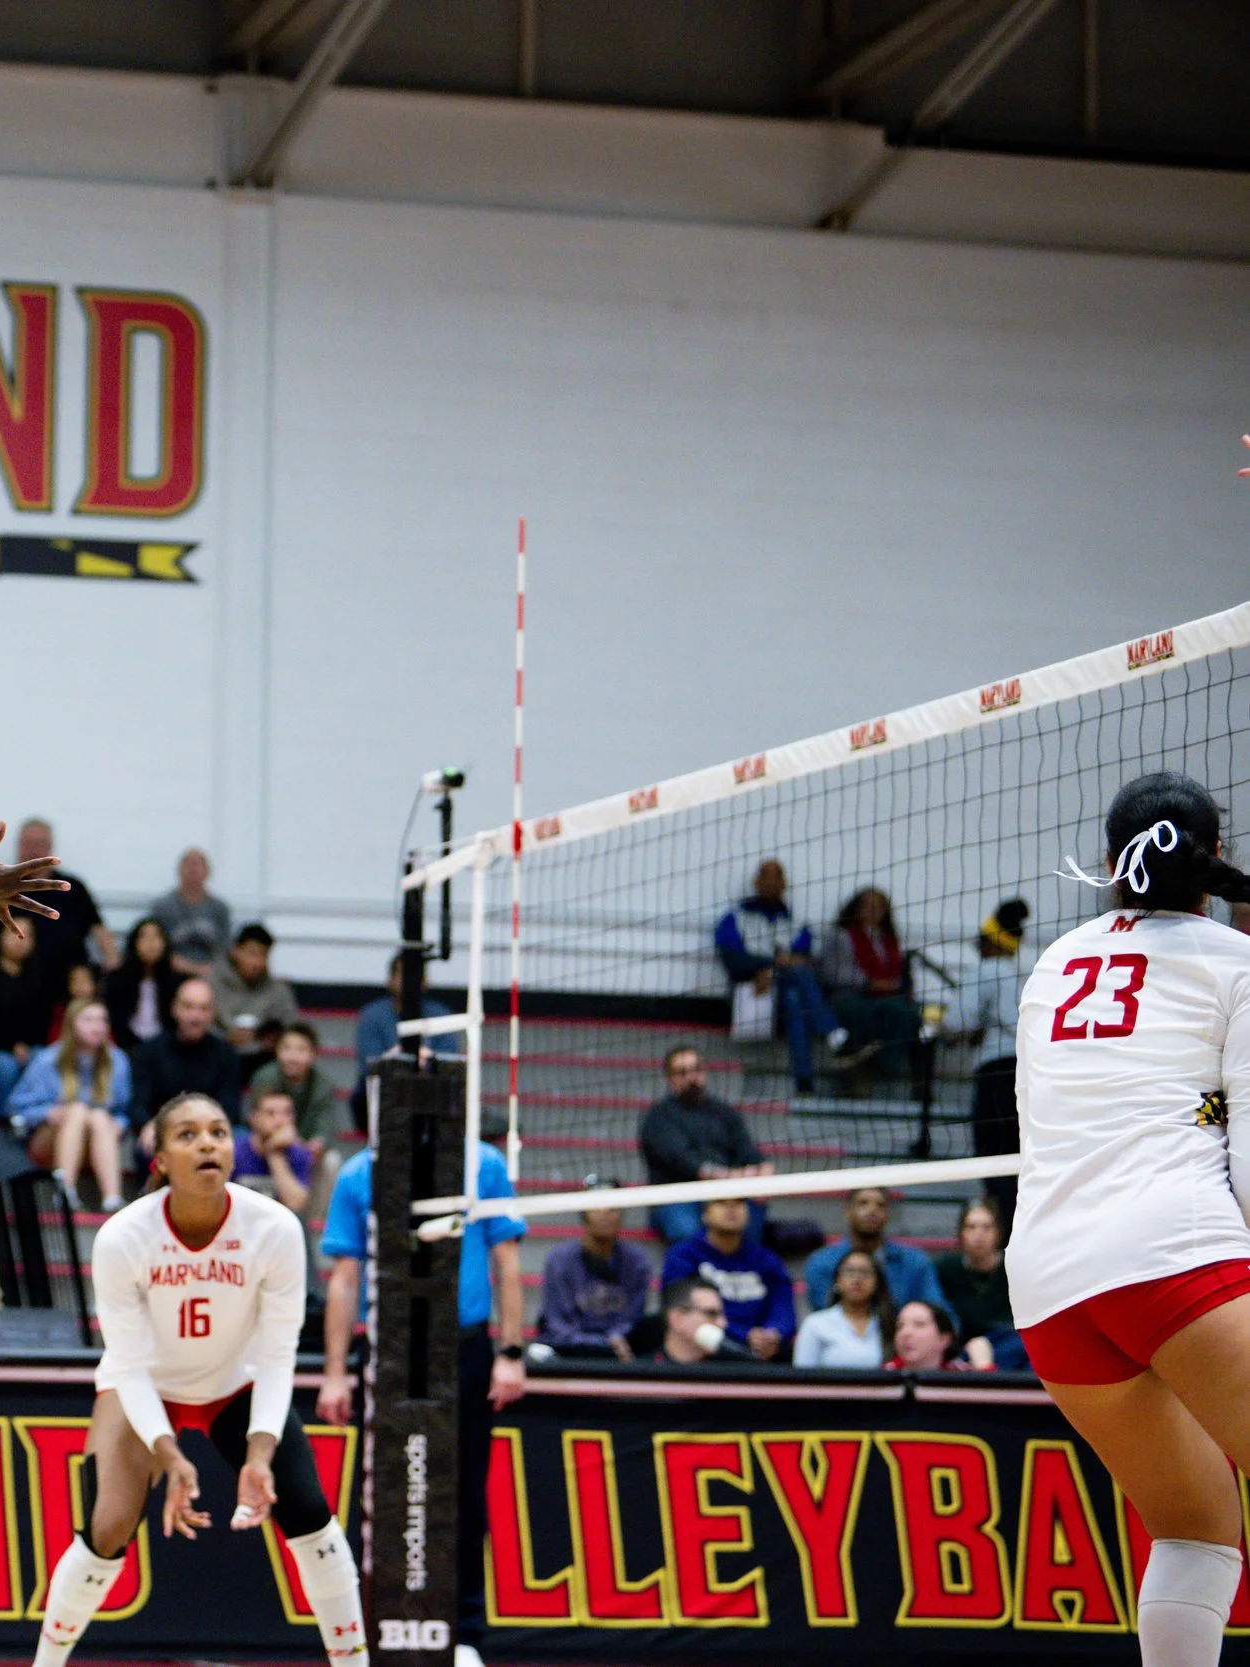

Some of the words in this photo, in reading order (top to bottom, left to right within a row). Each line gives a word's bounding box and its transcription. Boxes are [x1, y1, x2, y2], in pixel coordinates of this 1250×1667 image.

[1051, 953, 1148, 1042] 23
[148, 1258, 244, 1288] MARYLAND
[178, 1298, 210, 1338] 16
[405, 1434, 428, 1504] sports
[403, 1505, 427, 1591] imports
